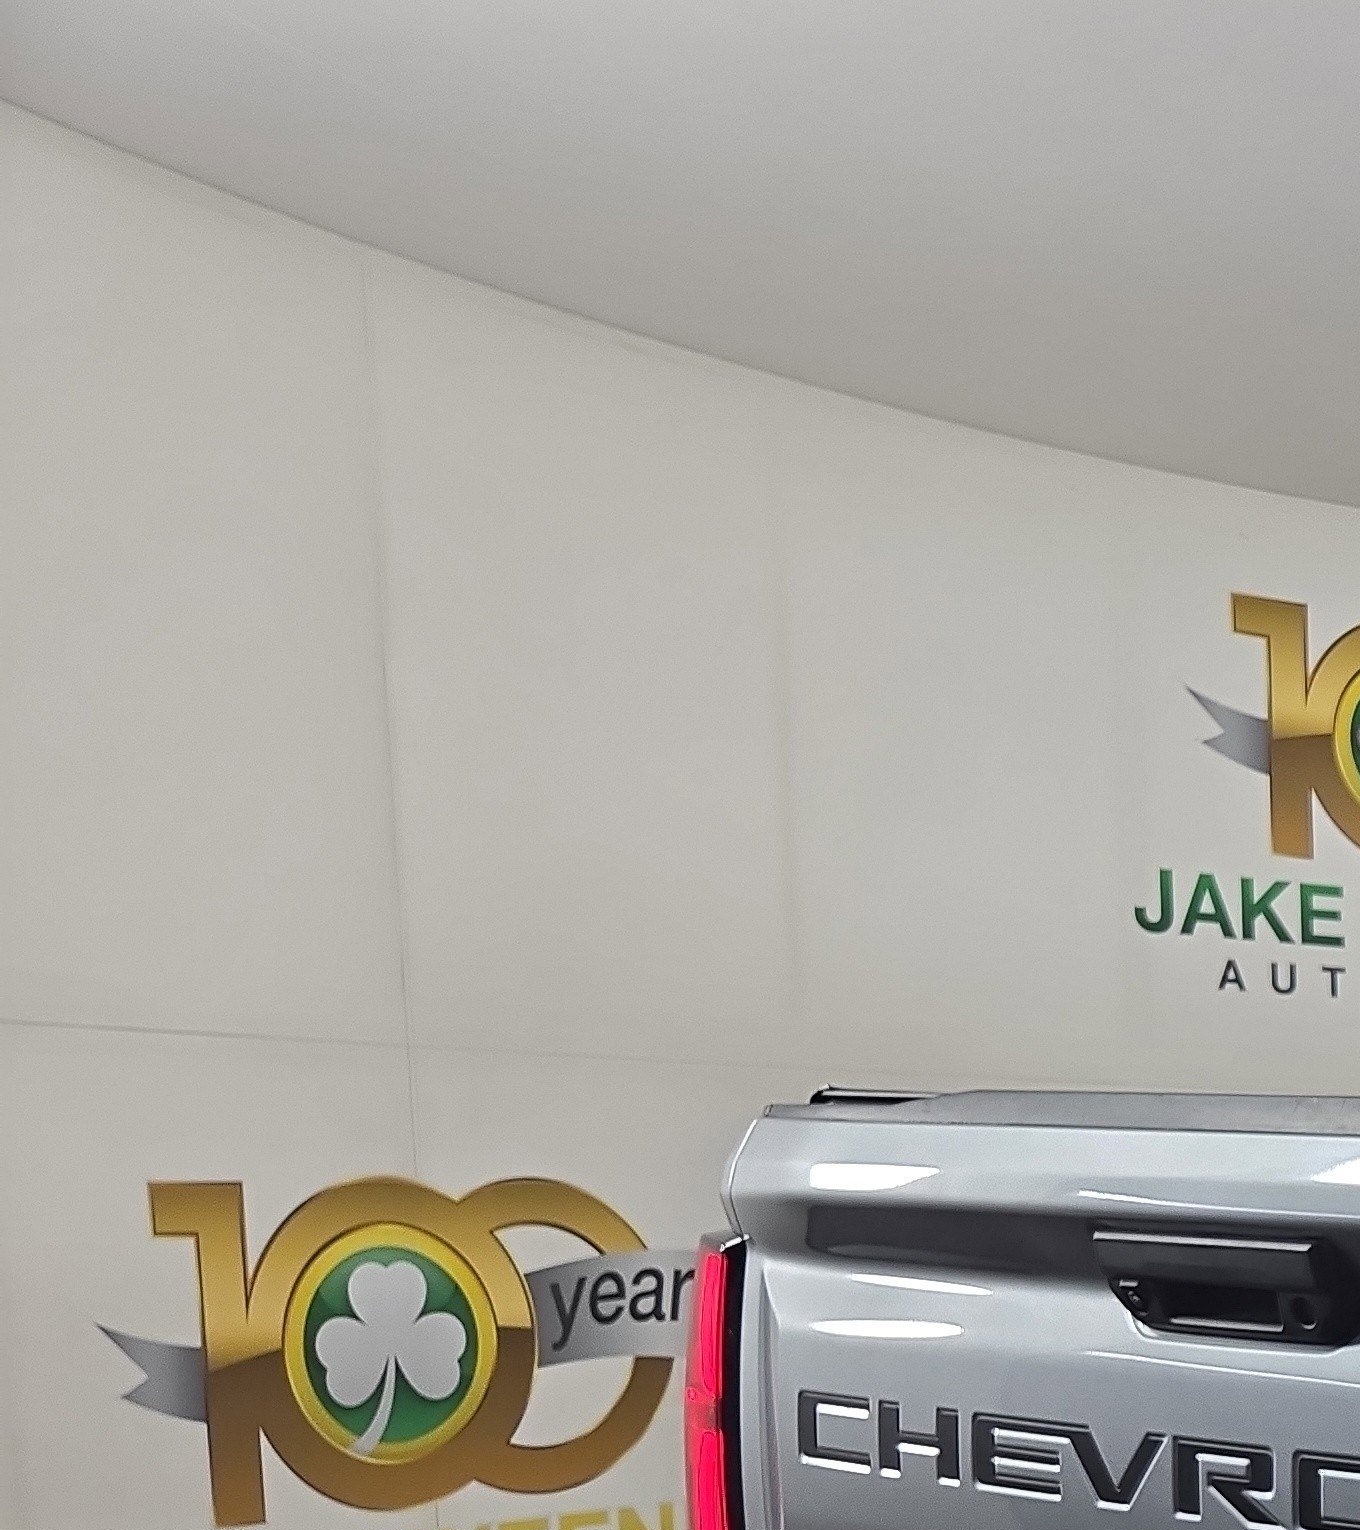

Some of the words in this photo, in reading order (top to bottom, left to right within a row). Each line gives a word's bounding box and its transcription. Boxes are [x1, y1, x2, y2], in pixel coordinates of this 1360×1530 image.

[1134, 868, 1346, 948] JAKE
[148, 1176, 674, 1528] 100
[550, 1266, 696, 1350] year
